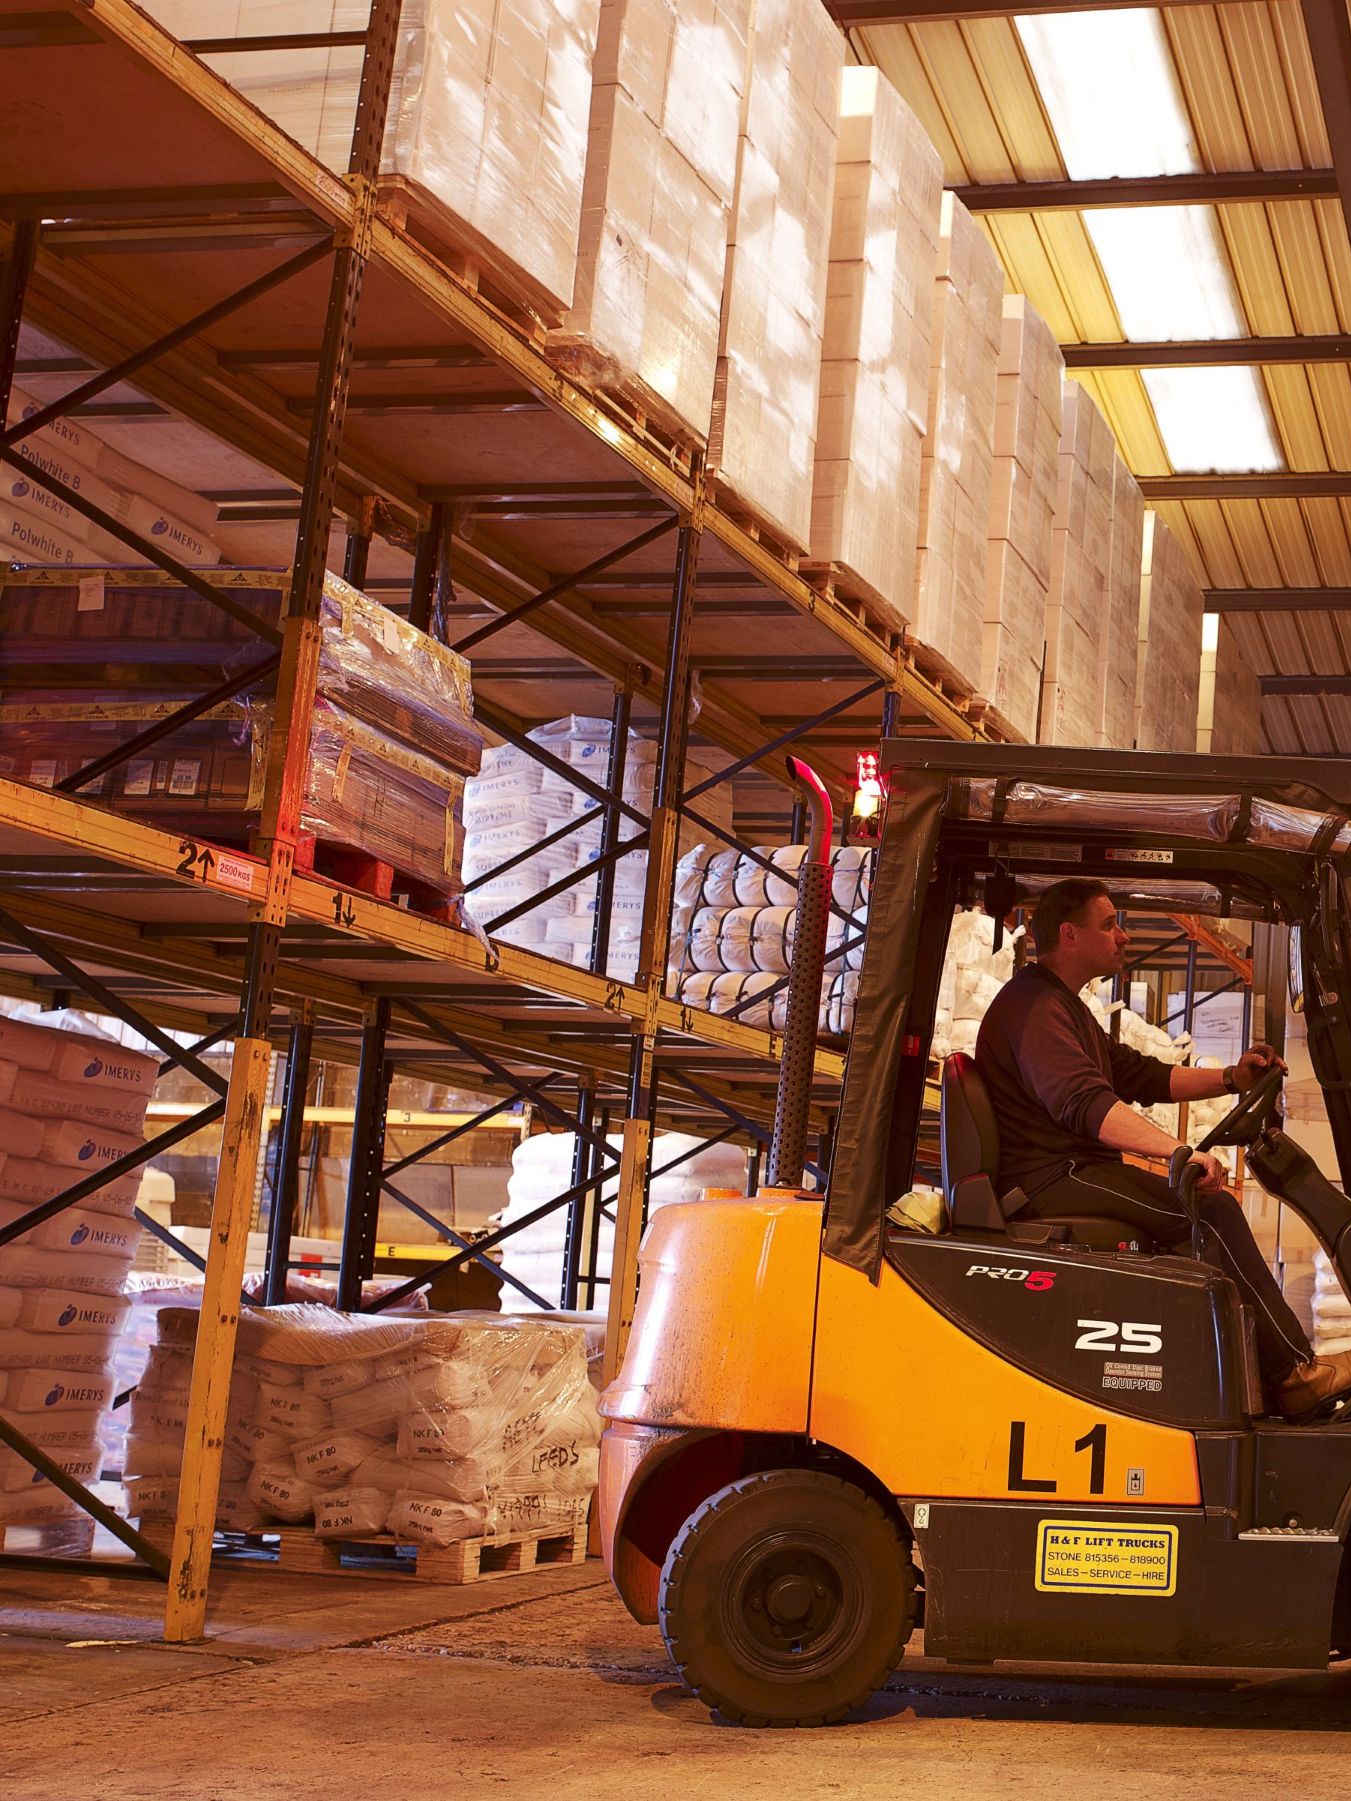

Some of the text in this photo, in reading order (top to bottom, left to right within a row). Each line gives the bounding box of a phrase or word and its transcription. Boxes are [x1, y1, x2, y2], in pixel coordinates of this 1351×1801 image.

[20, 444, 82, 490] Polwhite B
[31, 488, 71, 518] IMERYS
[11, 521, 74, 563] Polwhite B
[168, 526, 204, 555] IMERYS
[483, 780, 519, 791] IMERYS
[175, 840, 198, 879] 2
[220, 863, 238, 877] 2500
[238, 871, 250, 882] KGS
[332, 892, 343, 924] 1
[608, 952, 640, 960] MERYS
[605, 982, 616, 1010] 2
[104, 1064, 141, 1083] IMERYS
[404, 1112, 411, 1123] 3
[91, 1229, 128, 1246] IMERYS
[388, 1246, 395, 1256] E
[79, 1310, 116, 1325] IMERYS
[1075, 1319, 1163, 1354] 25
[1102, 1376, 1163, 1391] EQUIPPED
[66, 1390, 104, 1402] IMERYS
[326, 1446, 336, 1456] 80
[532, 1440, 579, 1473] LEEDS
[58, 1462, 93, 1475] MERYS
[279, 1489, 290, 1499] 80
[409, 1502, 422, 1511] NK
[431, 1507, 442, 1517] 80
[1050, 1536, 1165, 1548] H & F LIFT TRUCKS
[1048, 1552, 1165, 1565] STONE 815356 818900
[1047, 1567, 1164, 1580] SALES SERVICE HIRE
